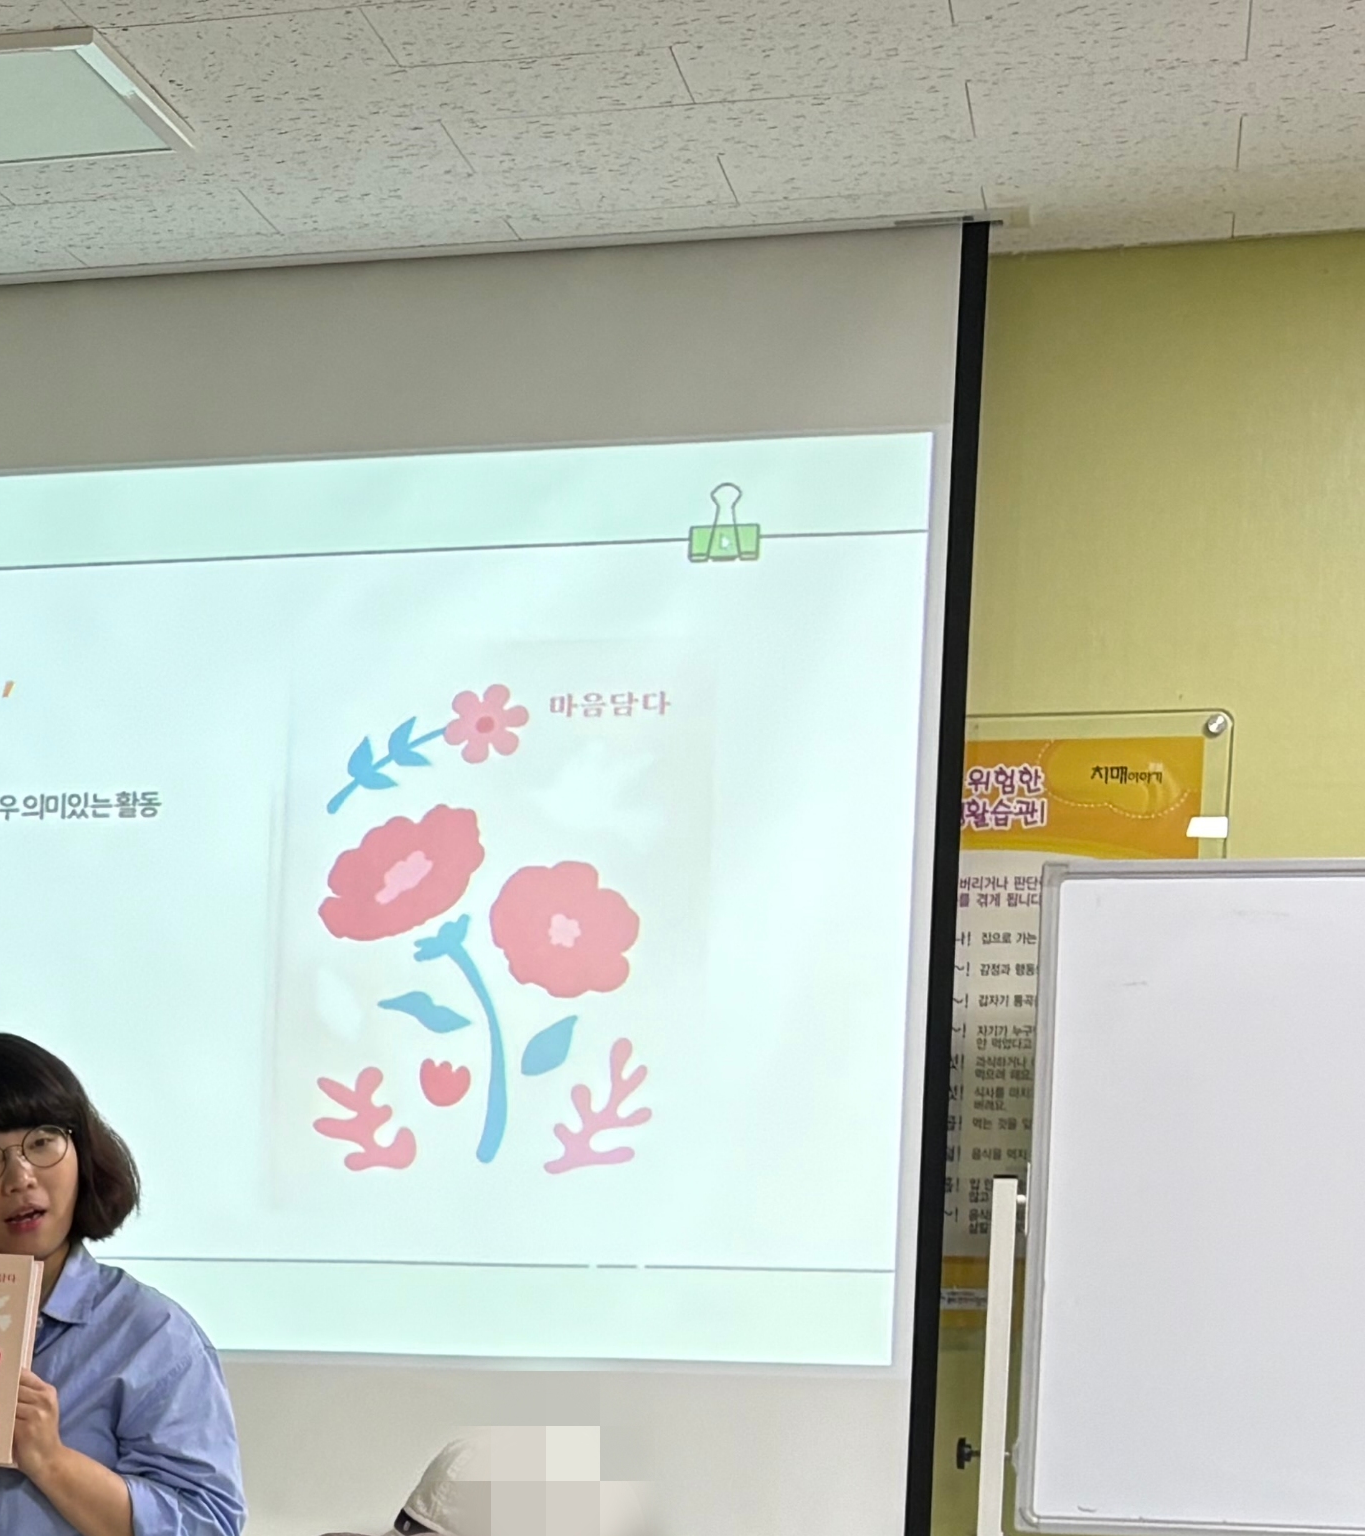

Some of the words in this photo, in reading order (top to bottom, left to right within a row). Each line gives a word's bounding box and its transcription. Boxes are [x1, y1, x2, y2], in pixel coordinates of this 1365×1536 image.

[549, 690, 672, 719] 마음담다
[966, 762, 1045, 797] 위험한
[1090, 764, 1164, 785] 치매이야기
[114, 791, 162, 819] 활동
[958, 875, 1010, 892] 버리거나
[1013, 875, 1042, 892] 판단
[976, 892, 1001, 908] 겪게
